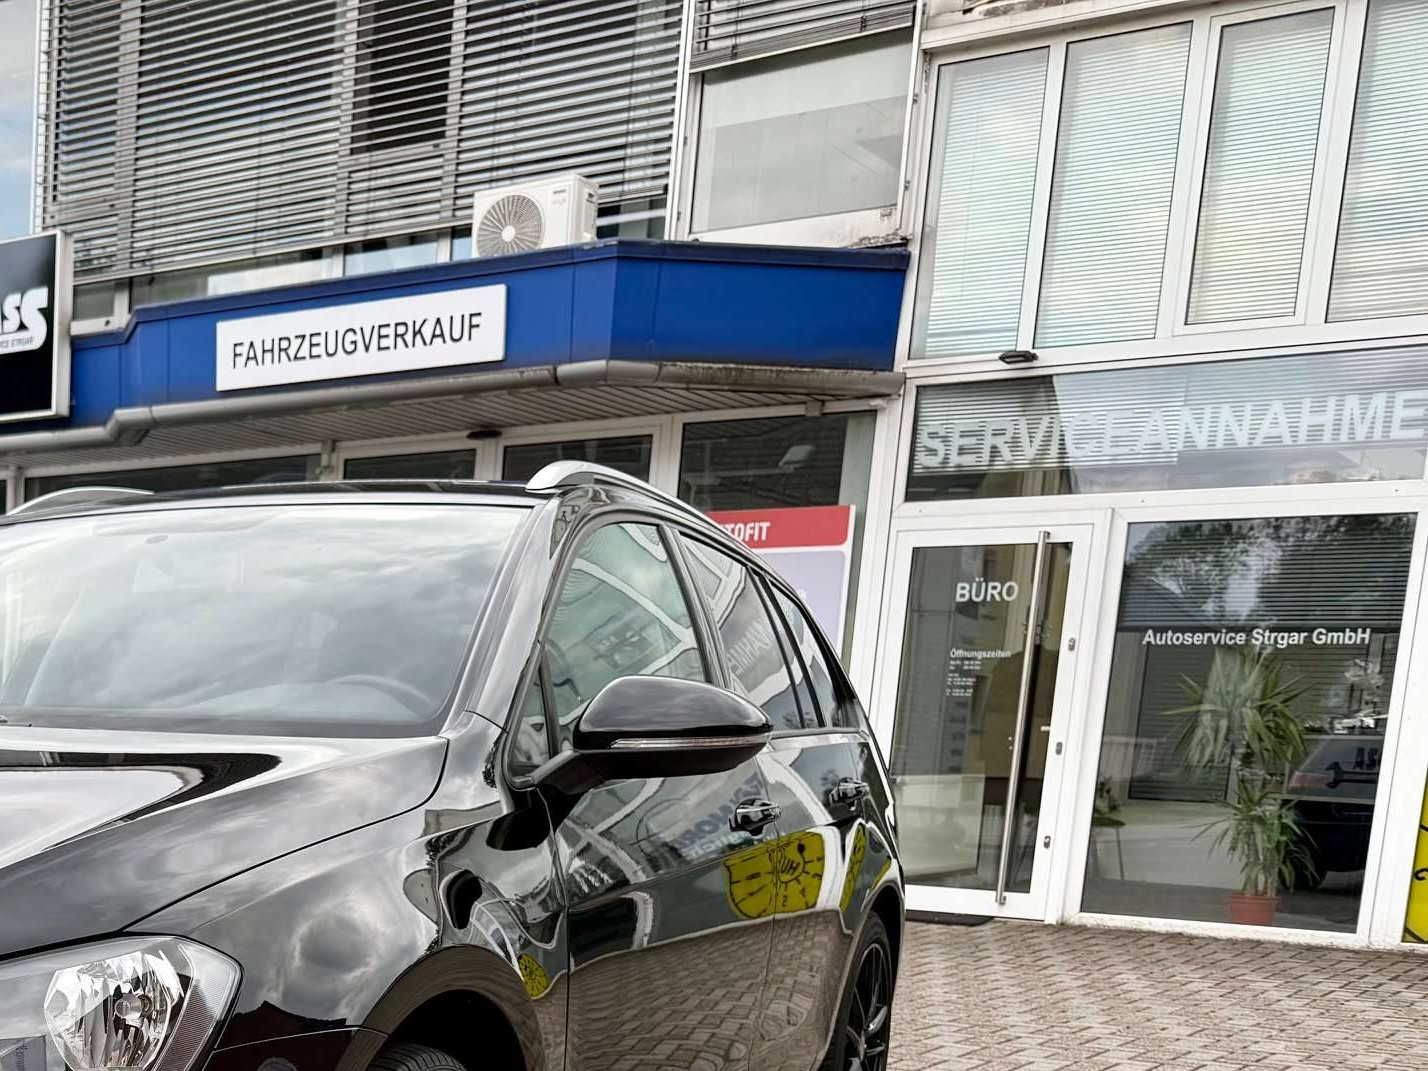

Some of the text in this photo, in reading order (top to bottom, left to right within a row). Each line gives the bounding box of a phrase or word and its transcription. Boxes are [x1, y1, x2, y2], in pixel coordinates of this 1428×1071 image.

[232, 312, 484, 370] FAHRZEUGVERKAUF
[917, 391, 1428, 467] SERVICEANNAHME
[722, 521, 771, 542] TOFIT
[955, 577, 1019, 603] BÜRO
[1142, 628, 1371, 649] Autoservice Strgar GmbH
[949, 647, 1011, 660] Öffnungszeiten
[1352, 746, 1380, 771] AS
